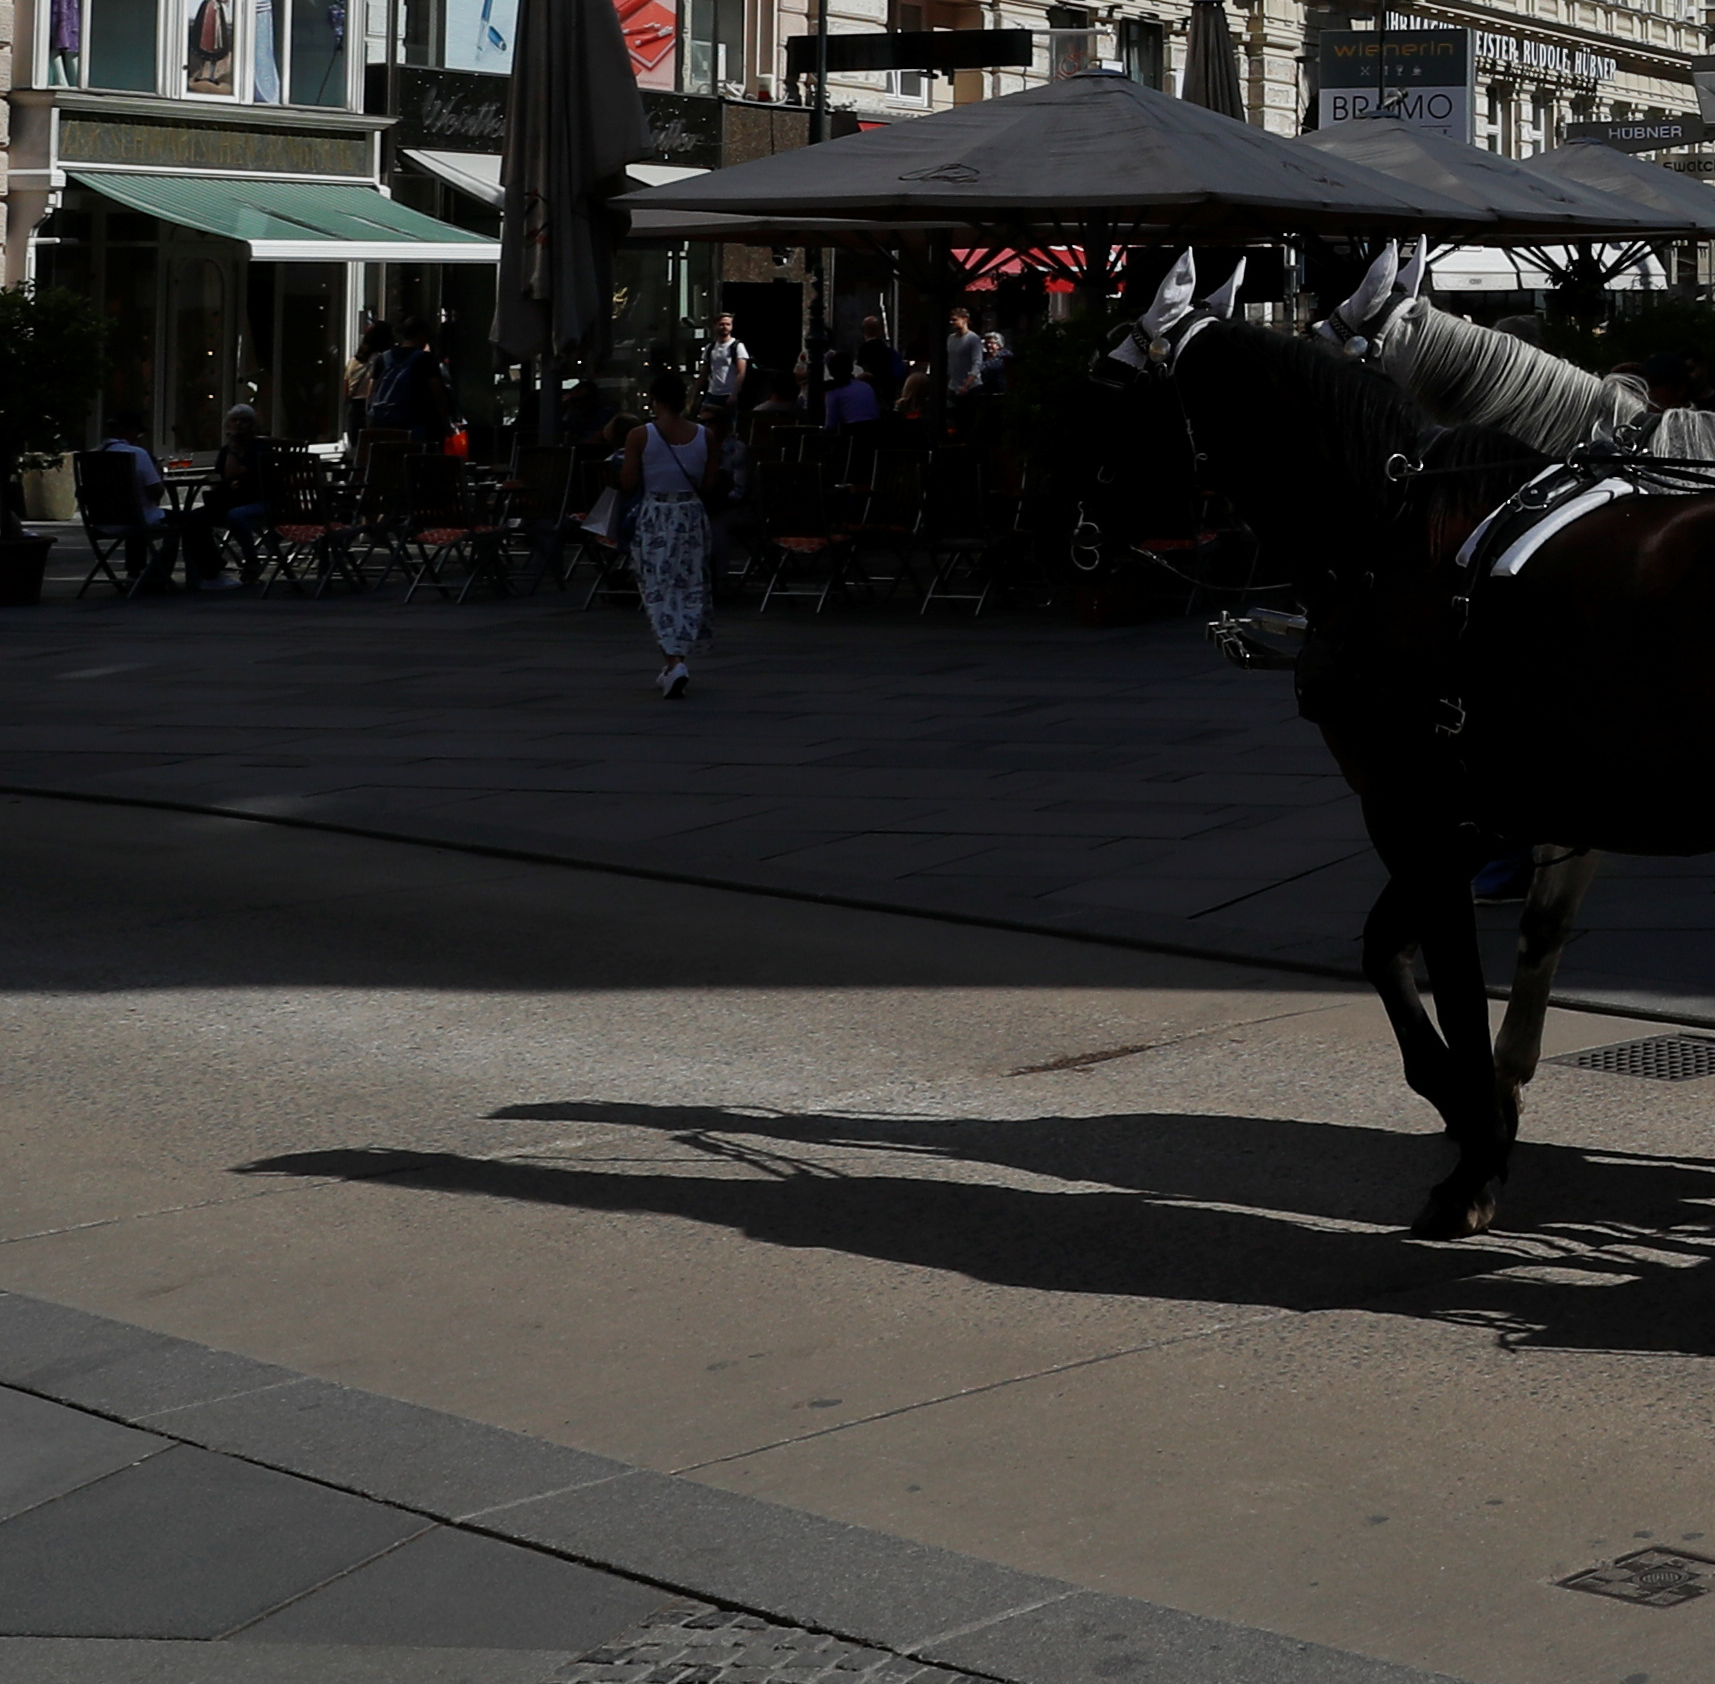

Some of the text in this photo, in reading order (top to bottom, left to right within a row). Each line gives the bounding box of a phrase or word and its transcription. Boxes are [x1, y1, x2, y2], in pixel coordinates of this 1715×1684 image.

[1333, 40, 1455, 58] wienerin
[1574, 47, 1617, 81] HÜBNER
[1332, 93, 1453, 122] BRMO
[1608, 125, 1683, 141] HÜBNER
